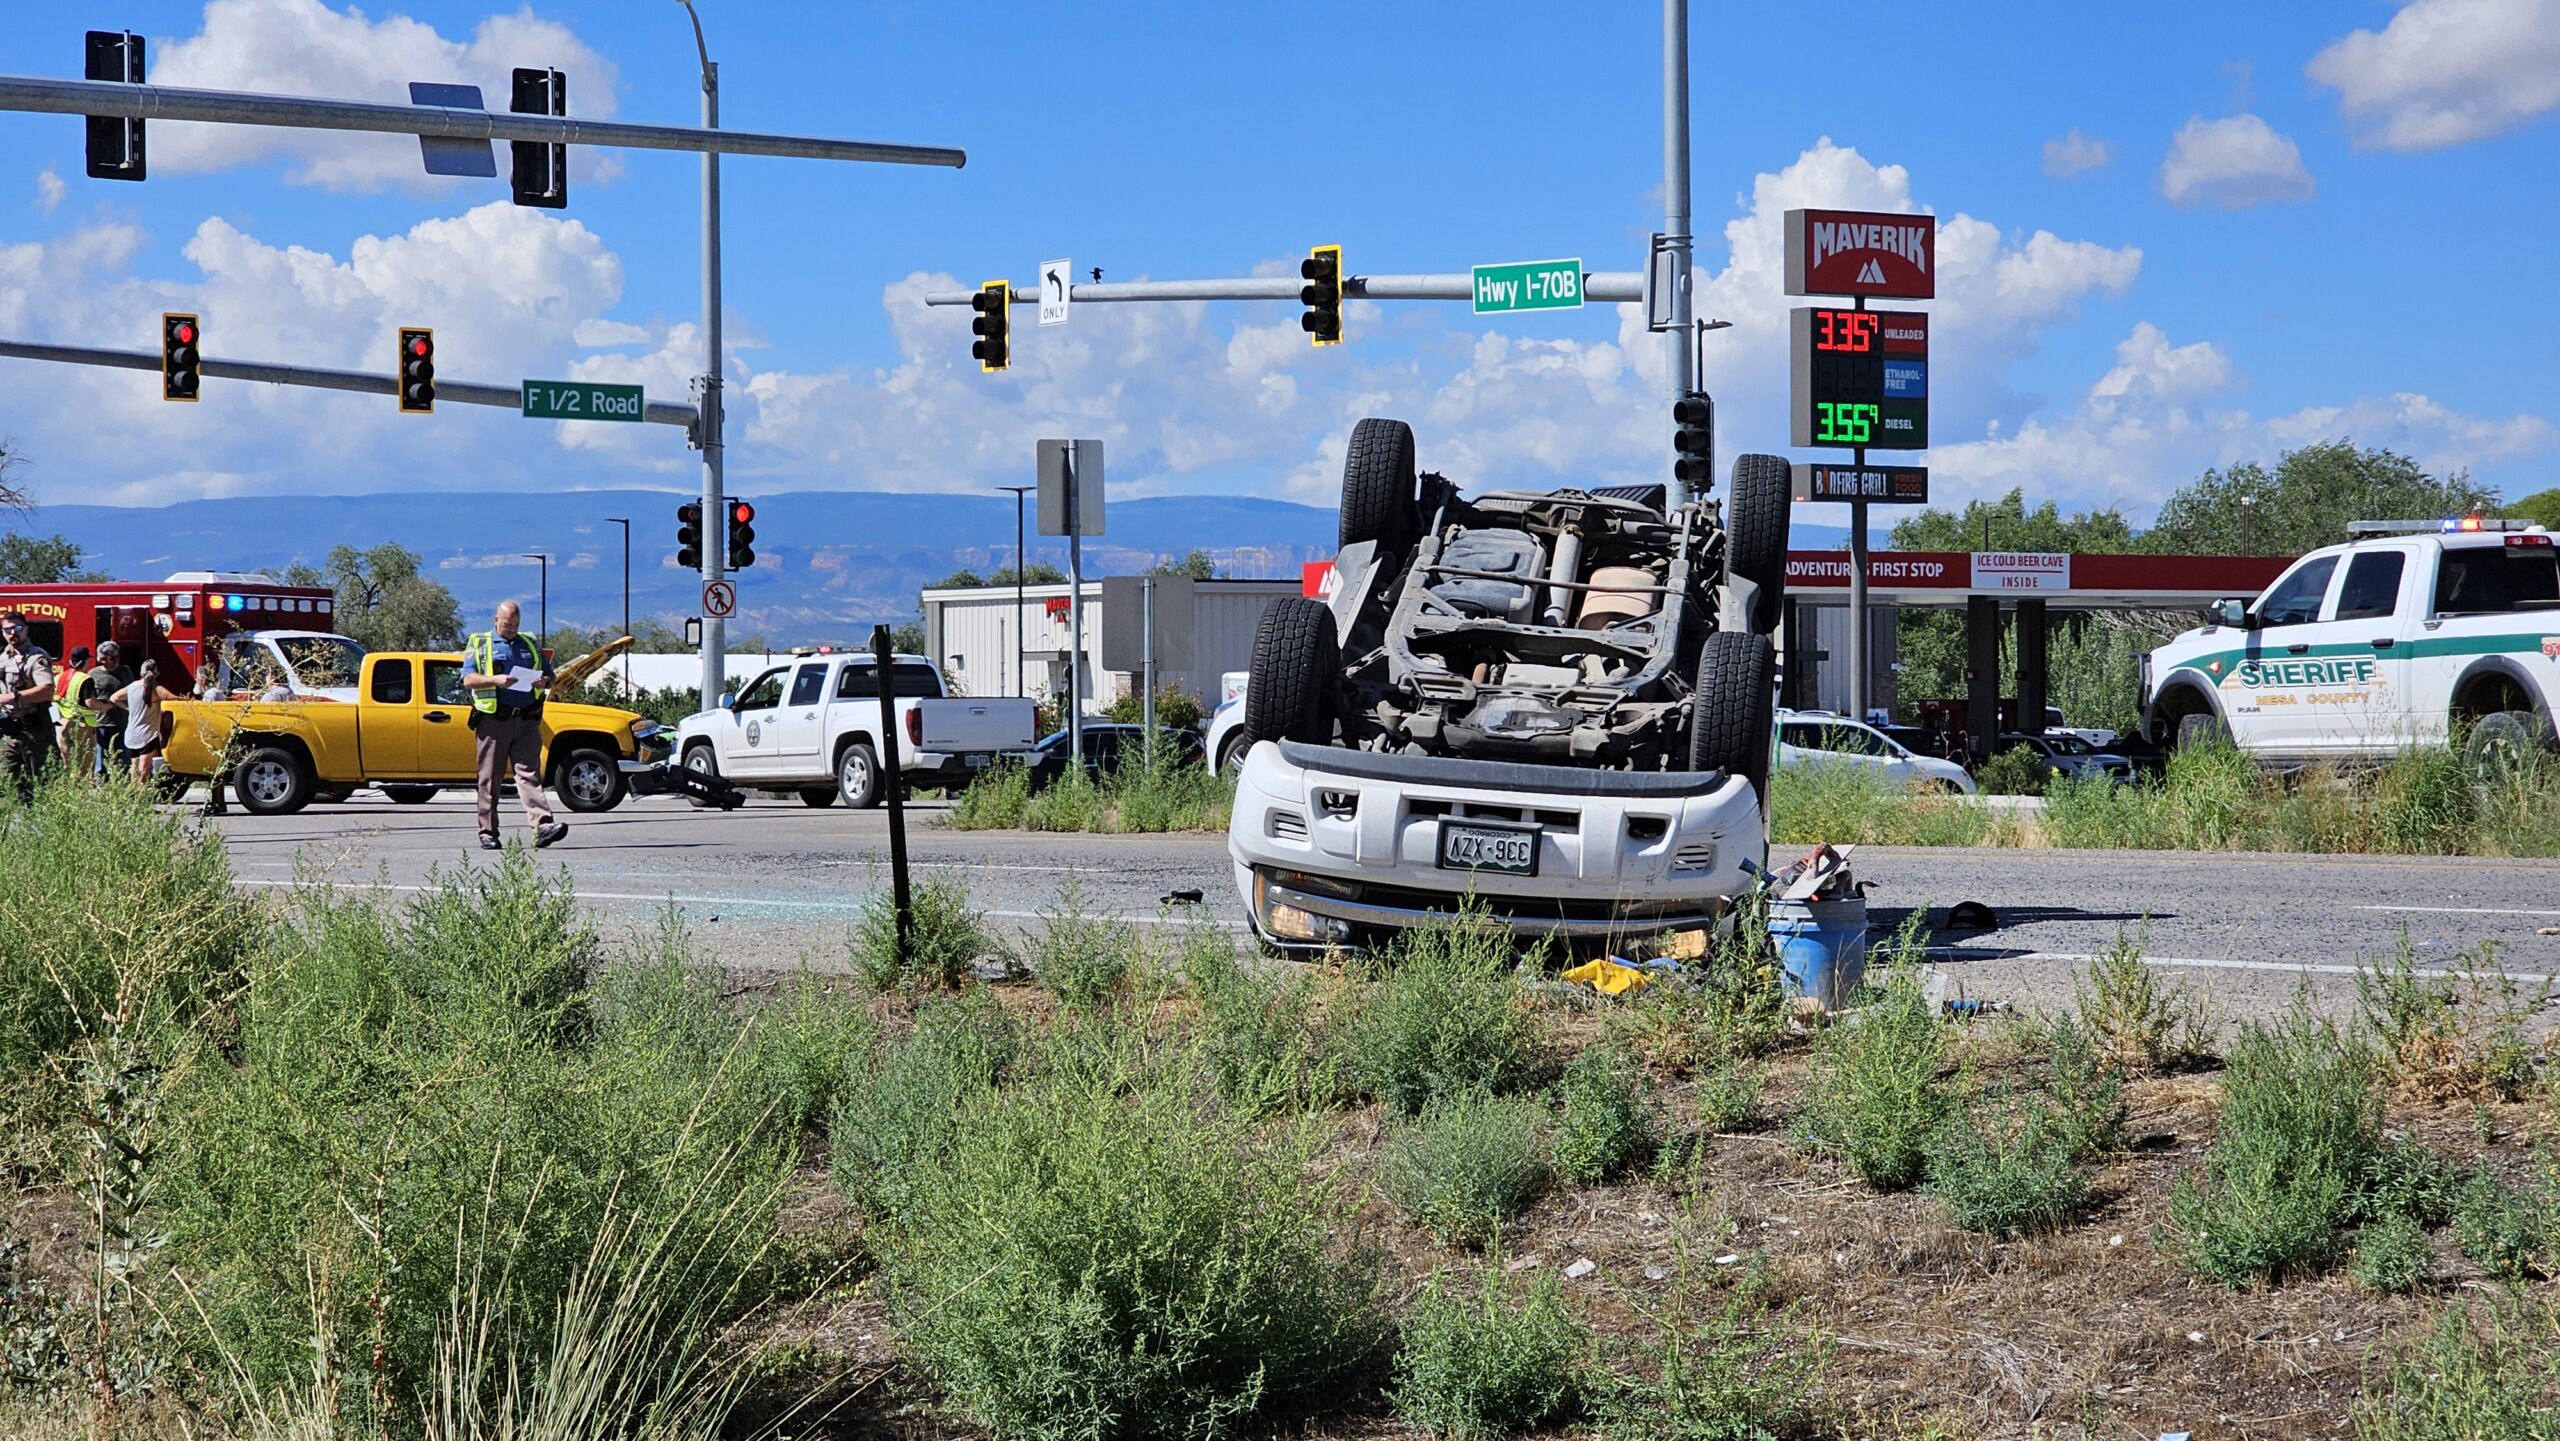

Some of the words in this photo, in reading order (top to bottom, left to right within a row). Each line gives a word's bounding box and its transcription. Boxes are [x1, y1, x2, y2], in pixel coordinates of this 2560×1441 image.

[1813, 222, 1925, 274] MAVERIK
[1478, 275, 1518, 308] Hwy
[1526, 270, 1577, 300] I-70B
[1043, 306, 1065, 319] ONLY
[1884, 328, 1924, 340] UNLEADED
[1884, 379, 1907, 390] FREE
[528, 388, 541, 410] F
[548, 389, 580, 412] 1/2
[592, 391, 639, 414] Road
[1885, 419, 1914, 429] DIESEL
[1977, 555, 1991, 566] ICE
[1993, 555, 2015, 567] COLD
[2018, 556, 2040, 567] BEER
[2041, 556, 2064, 567] CAVE
[1872, 563, 1908, 577] FIRST
[1911, 563, 1944, 578] STOP
[2002, 576, 2038, 587] INSIDE
[2238, 659, 2375, 689] SHERIFF
[2256, 694, 2298, 706] MESA
[2306, 692, 2371, 705] COUNTY
